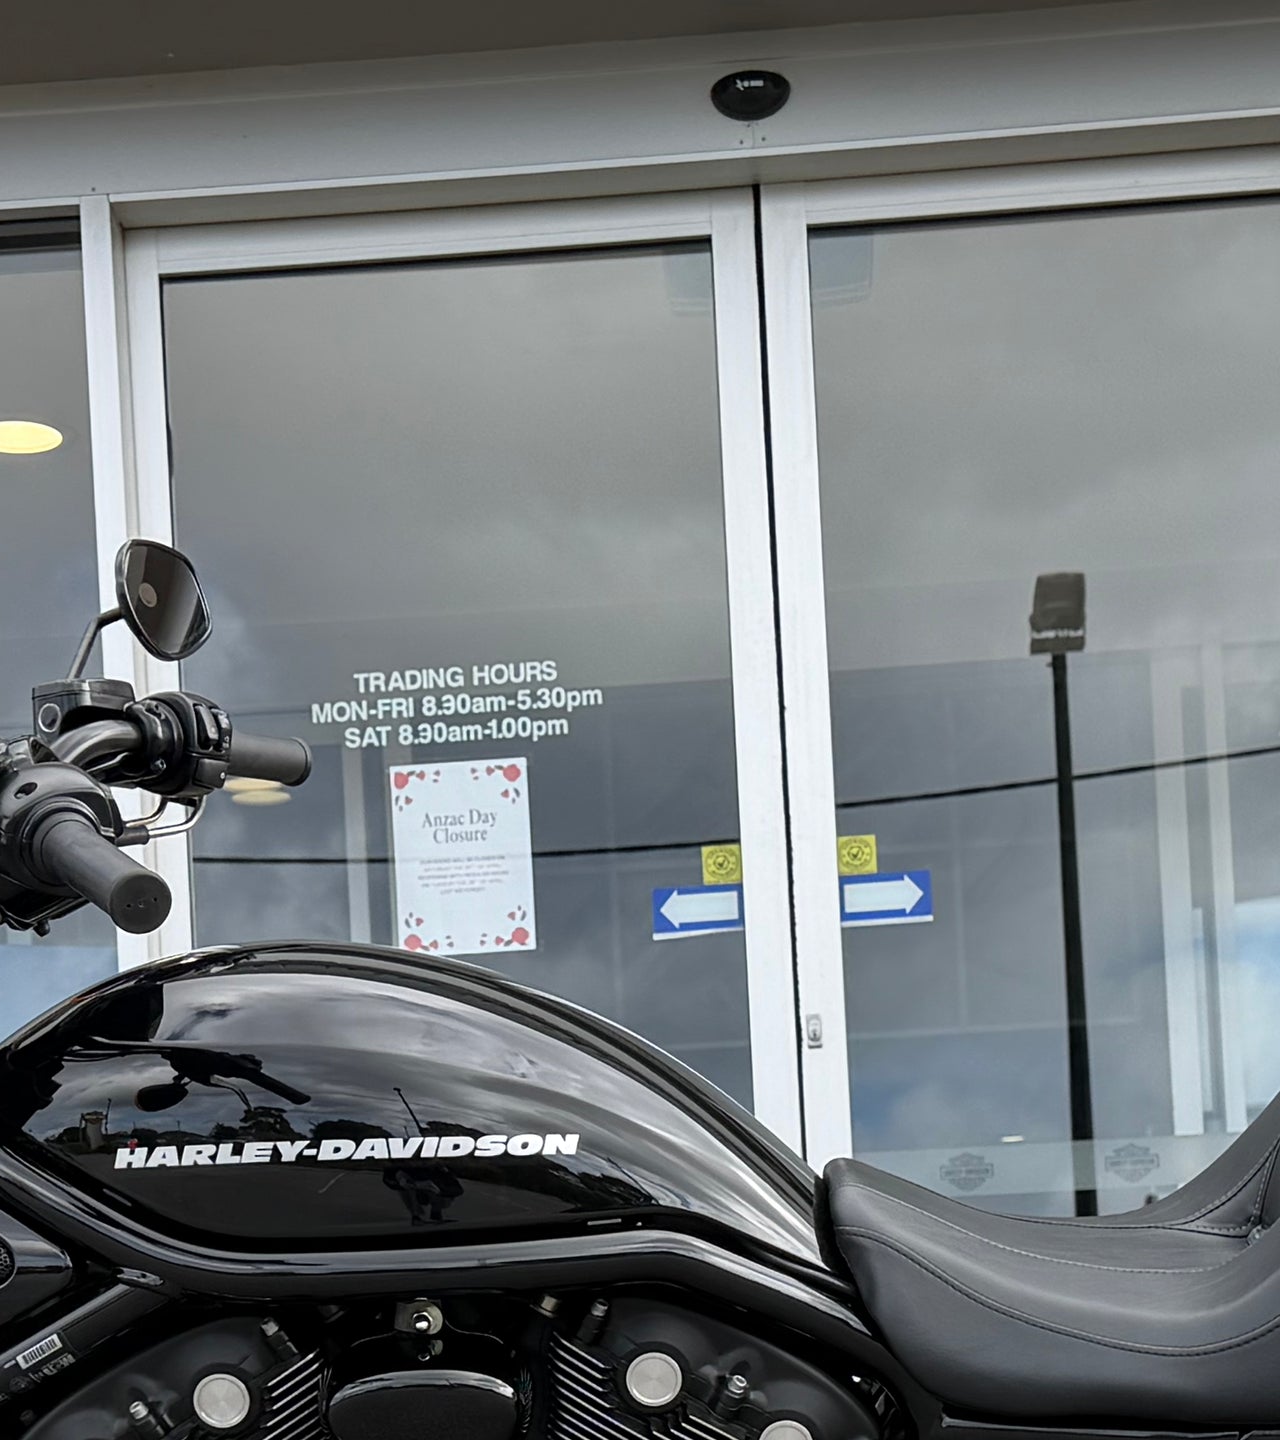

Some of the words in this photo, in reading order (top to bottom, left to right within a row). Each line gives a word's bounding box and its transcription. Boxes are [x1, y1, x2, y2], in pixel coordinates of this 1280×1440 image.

[353, 667, 464, 693] TRADING
[472, 660, 557, 686] HOURS
[311, 698, 415, 723] MON-FRI
[344, 725, 391, 748] SAT
[421, 812, 465, 829] Anzac
[468, 808, 498, 828] Day
[433, 827, 488, 844] Closure
[113, 1133, 580, 1169] HARLEY-DAVIDSON
